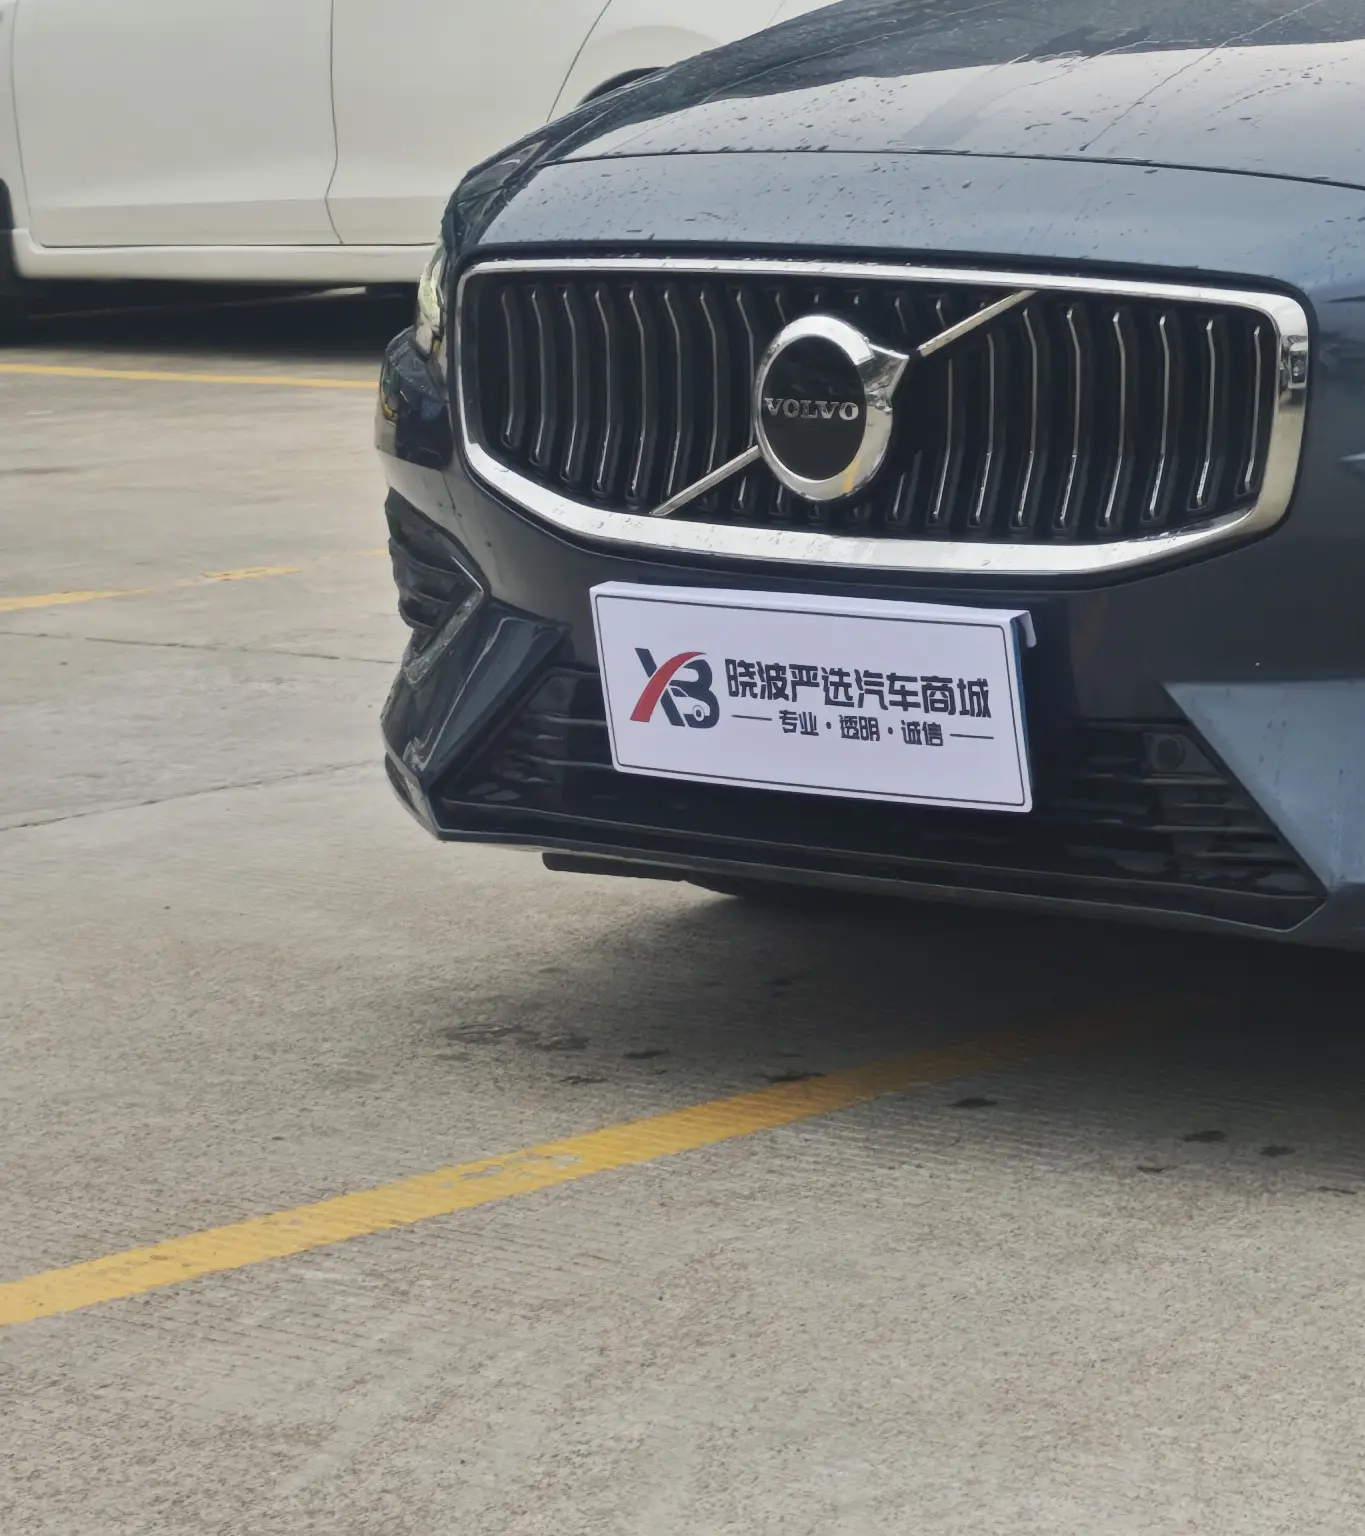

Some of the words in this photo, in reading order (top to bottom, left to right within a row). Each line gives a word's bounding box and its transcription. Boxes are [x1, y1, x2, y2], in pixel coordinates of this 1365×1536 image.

[764, 397, 859, 421] VOLVO
[725, 658, 992, 719] 晓波严选汽车商城
